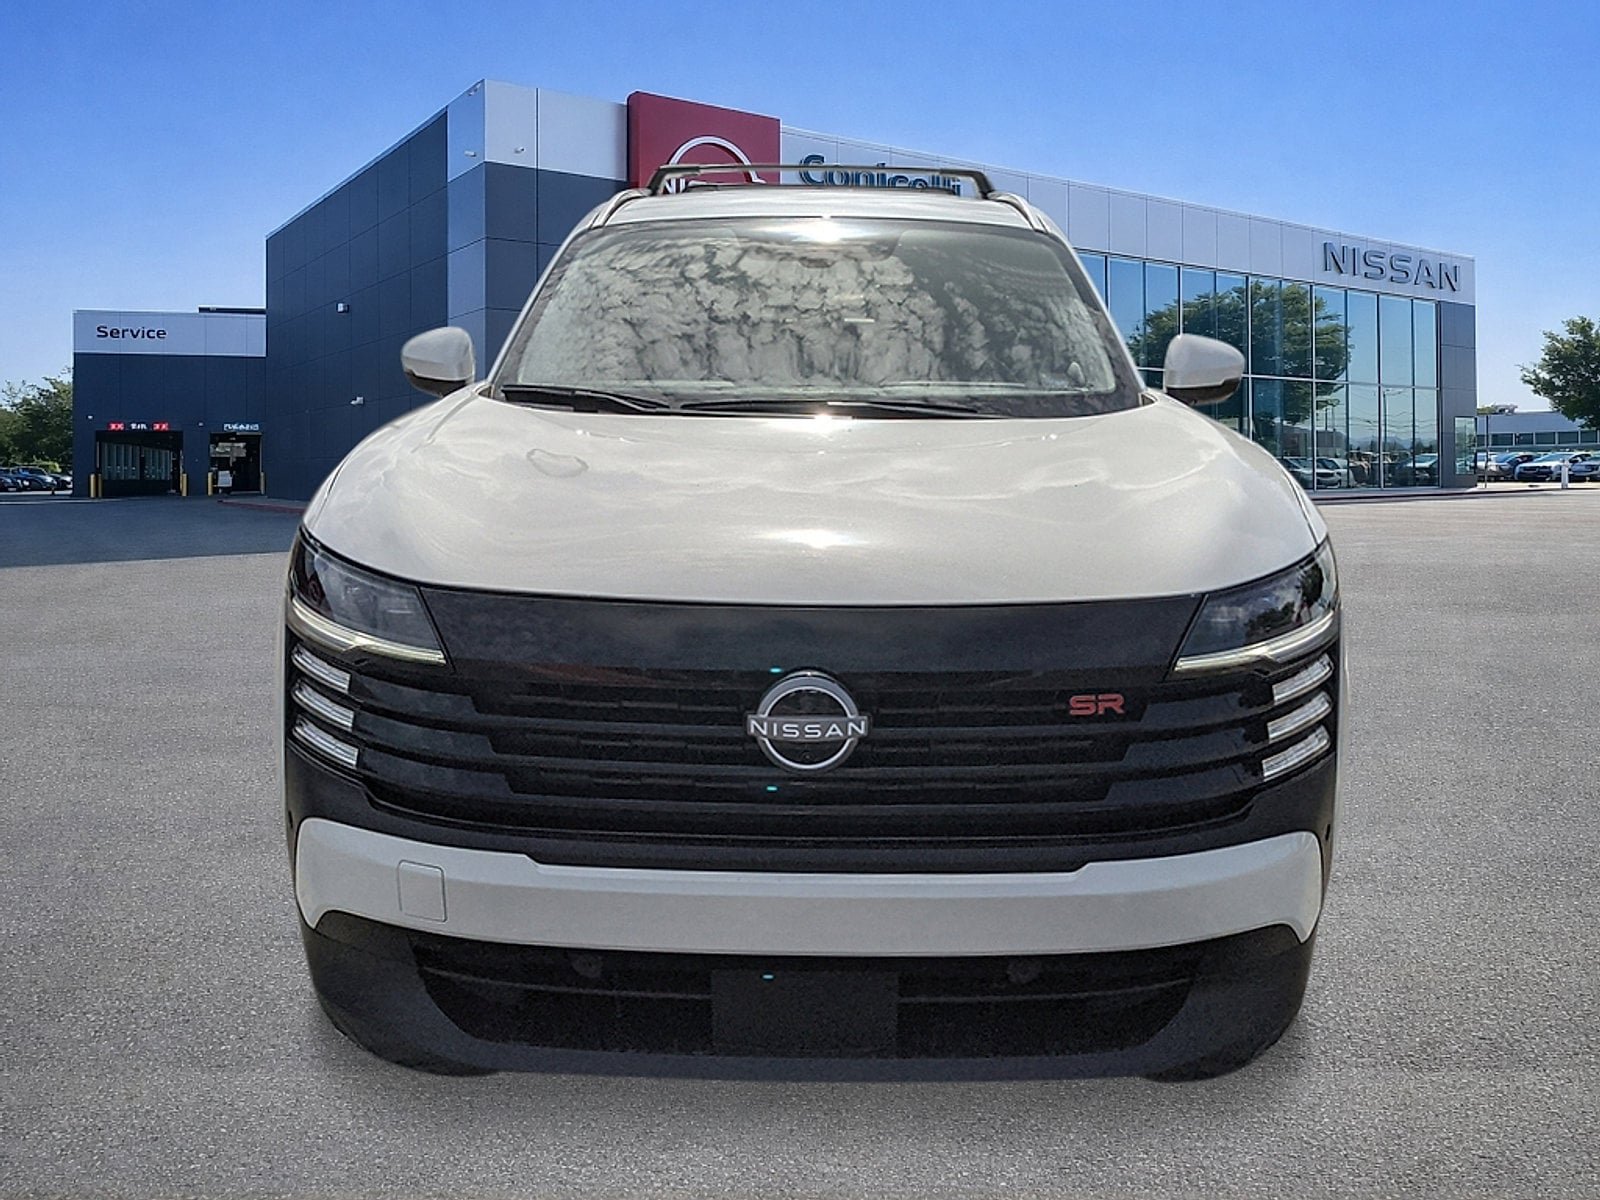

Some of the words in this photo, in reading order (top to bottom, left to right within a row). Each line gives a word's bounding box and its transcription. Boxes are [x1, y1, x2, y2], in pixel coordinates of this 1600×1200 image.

[1323, 242, 1461, 292] NISSAN
[96, 325, 167, 339] Service
[1069, 694, 1124, 716] SR
[750, 719, 867, 739] NISSAN
